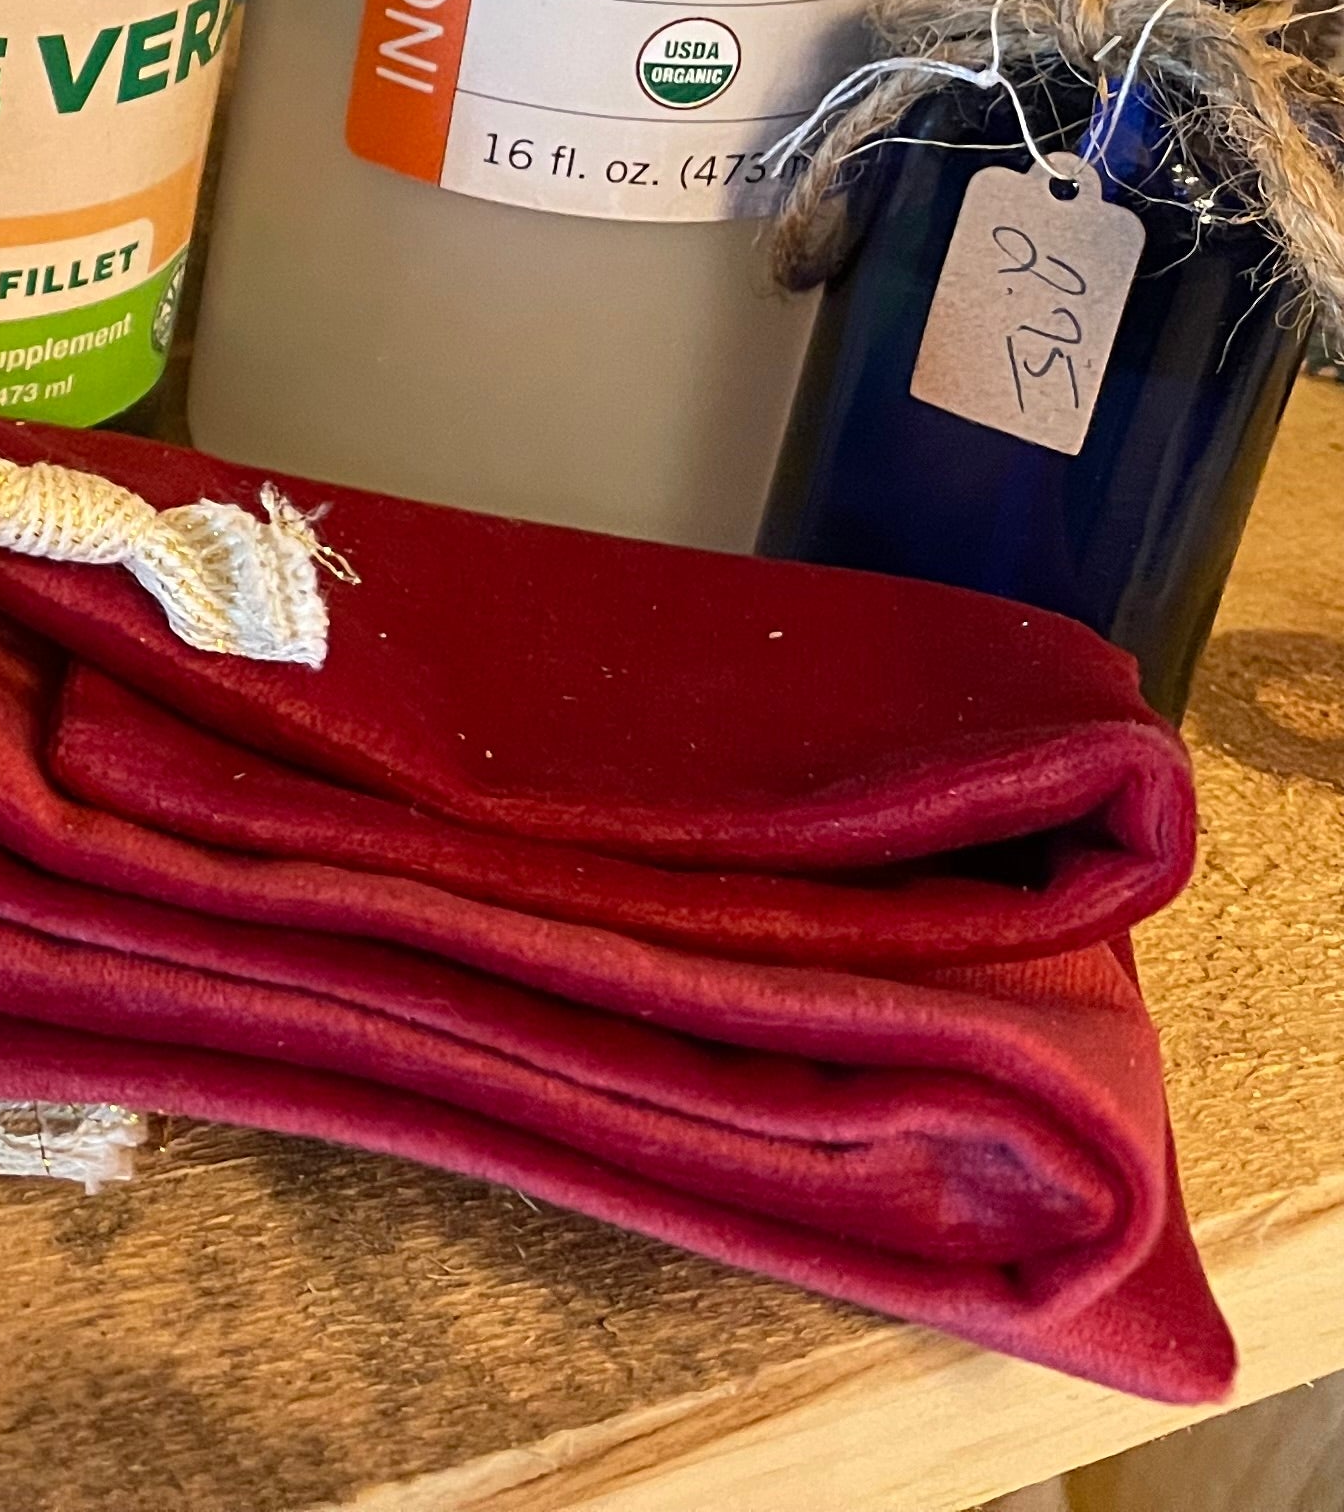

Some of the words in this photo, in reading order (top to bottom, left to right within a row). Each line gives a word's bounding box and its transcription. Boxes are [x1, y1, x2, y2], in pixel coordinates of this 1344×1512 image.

[664, 39, 720, 61] USDA
[650, 64, 724, 87] ORGANIC
[483, 131, 533, 171] 16
[552, 149, 588, 181] fl.
[605, 162, 660, 186] oz.
[44, 374, 75, 400] ml
